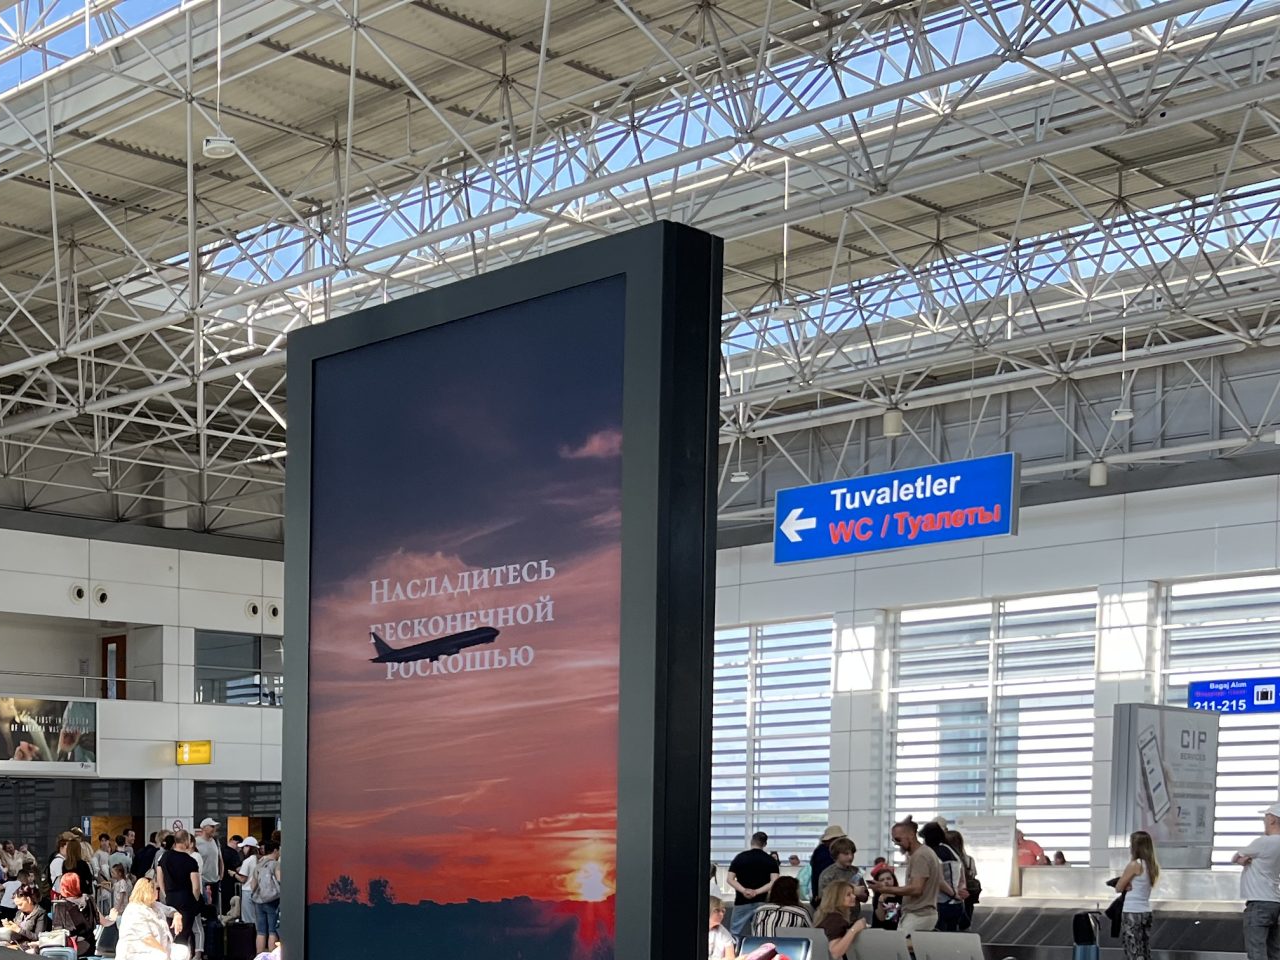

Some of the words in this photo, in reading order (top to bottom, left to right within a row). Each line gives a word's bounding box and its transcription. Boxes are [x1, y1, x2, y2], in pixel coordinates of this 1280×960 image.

[830, 474, 961, 511] Tuvaletler
[829, 518, 873, 545] WC
[880, 515, 890, 538] /
[894, 504, 1001, 539] Туалеты
[370, 560, 556, 605] НАСЛАДИТЕСЬ
[385, 645, 535, 680] РОСКОШЬЮ
[1193, 699, 1247, 711] 211-215
[1180, 730, 1207, 750] CIP
